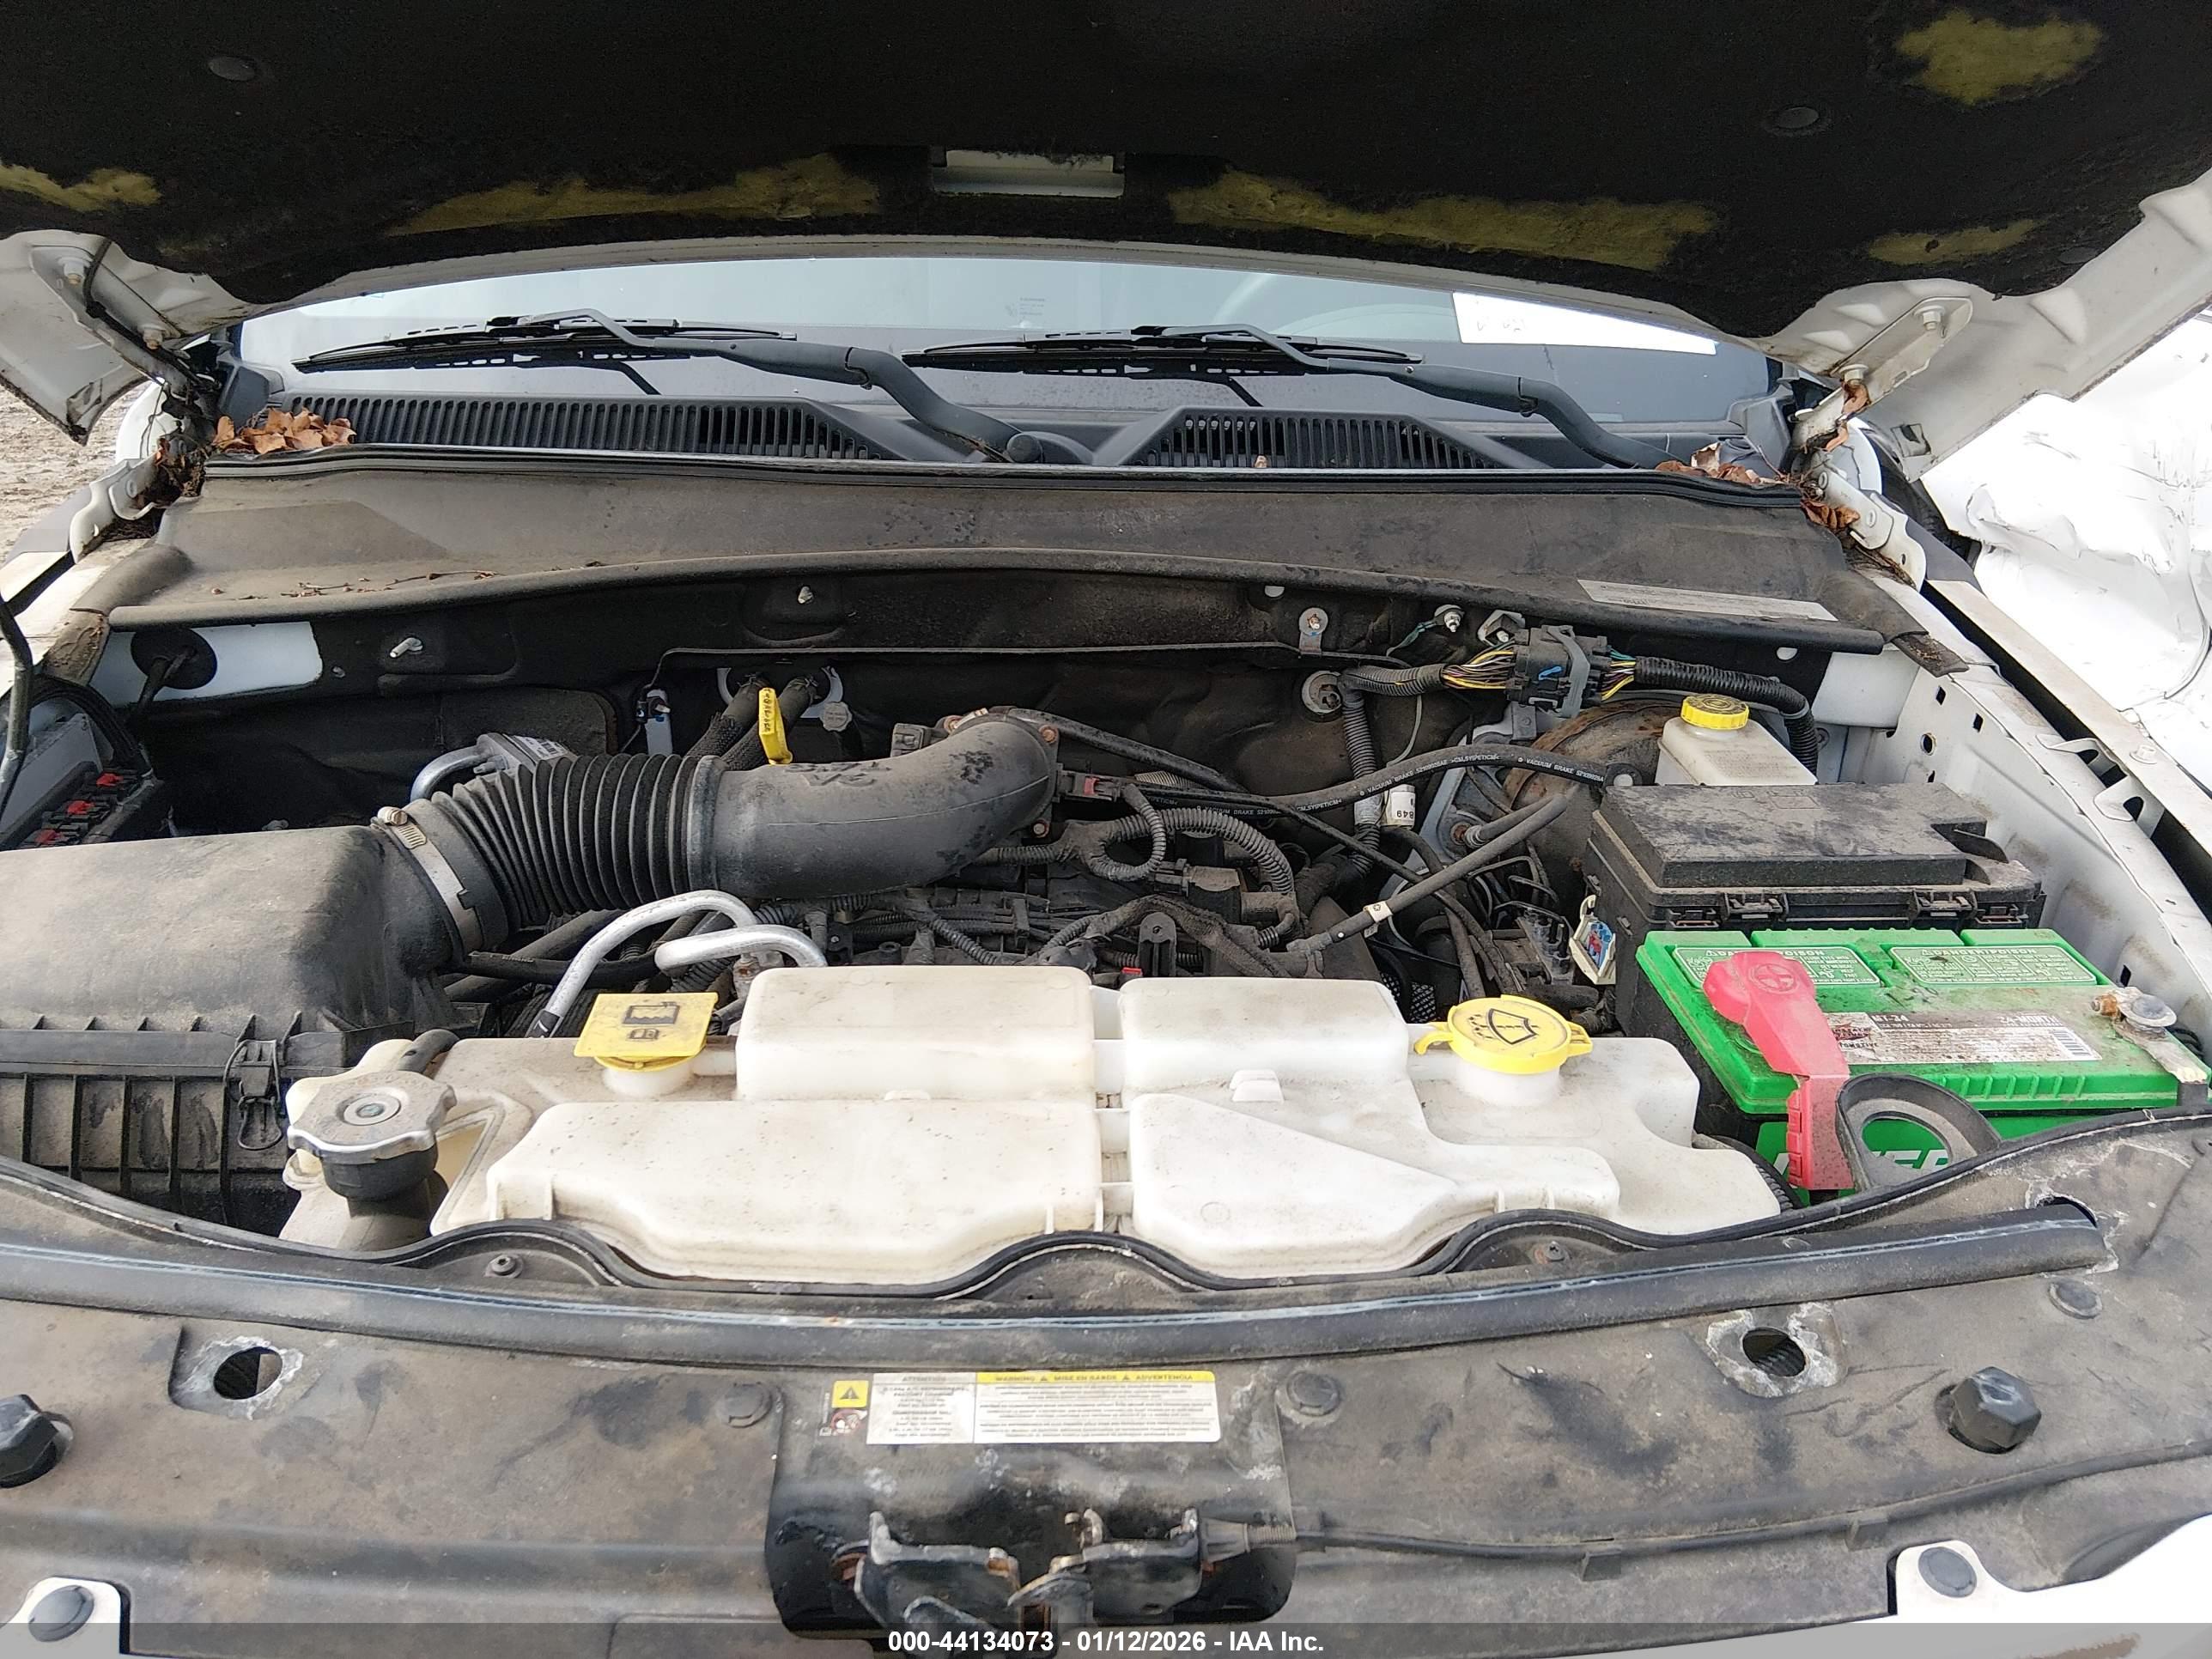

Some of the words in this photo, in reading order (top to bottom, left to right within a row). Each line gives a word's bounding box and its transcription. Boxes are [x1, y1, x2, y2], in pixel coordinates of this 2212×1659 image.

[1526, 758, 1553, 769] VACUUM
[1553, 764, 1574, 774] BRAKE
[800, 772, 877, 787] V6
[1367, 780, 1393, 793] VACUUM
[1395, 770, 1414, 782] BRAKE
[1396, 811, 1414, 819] 849
